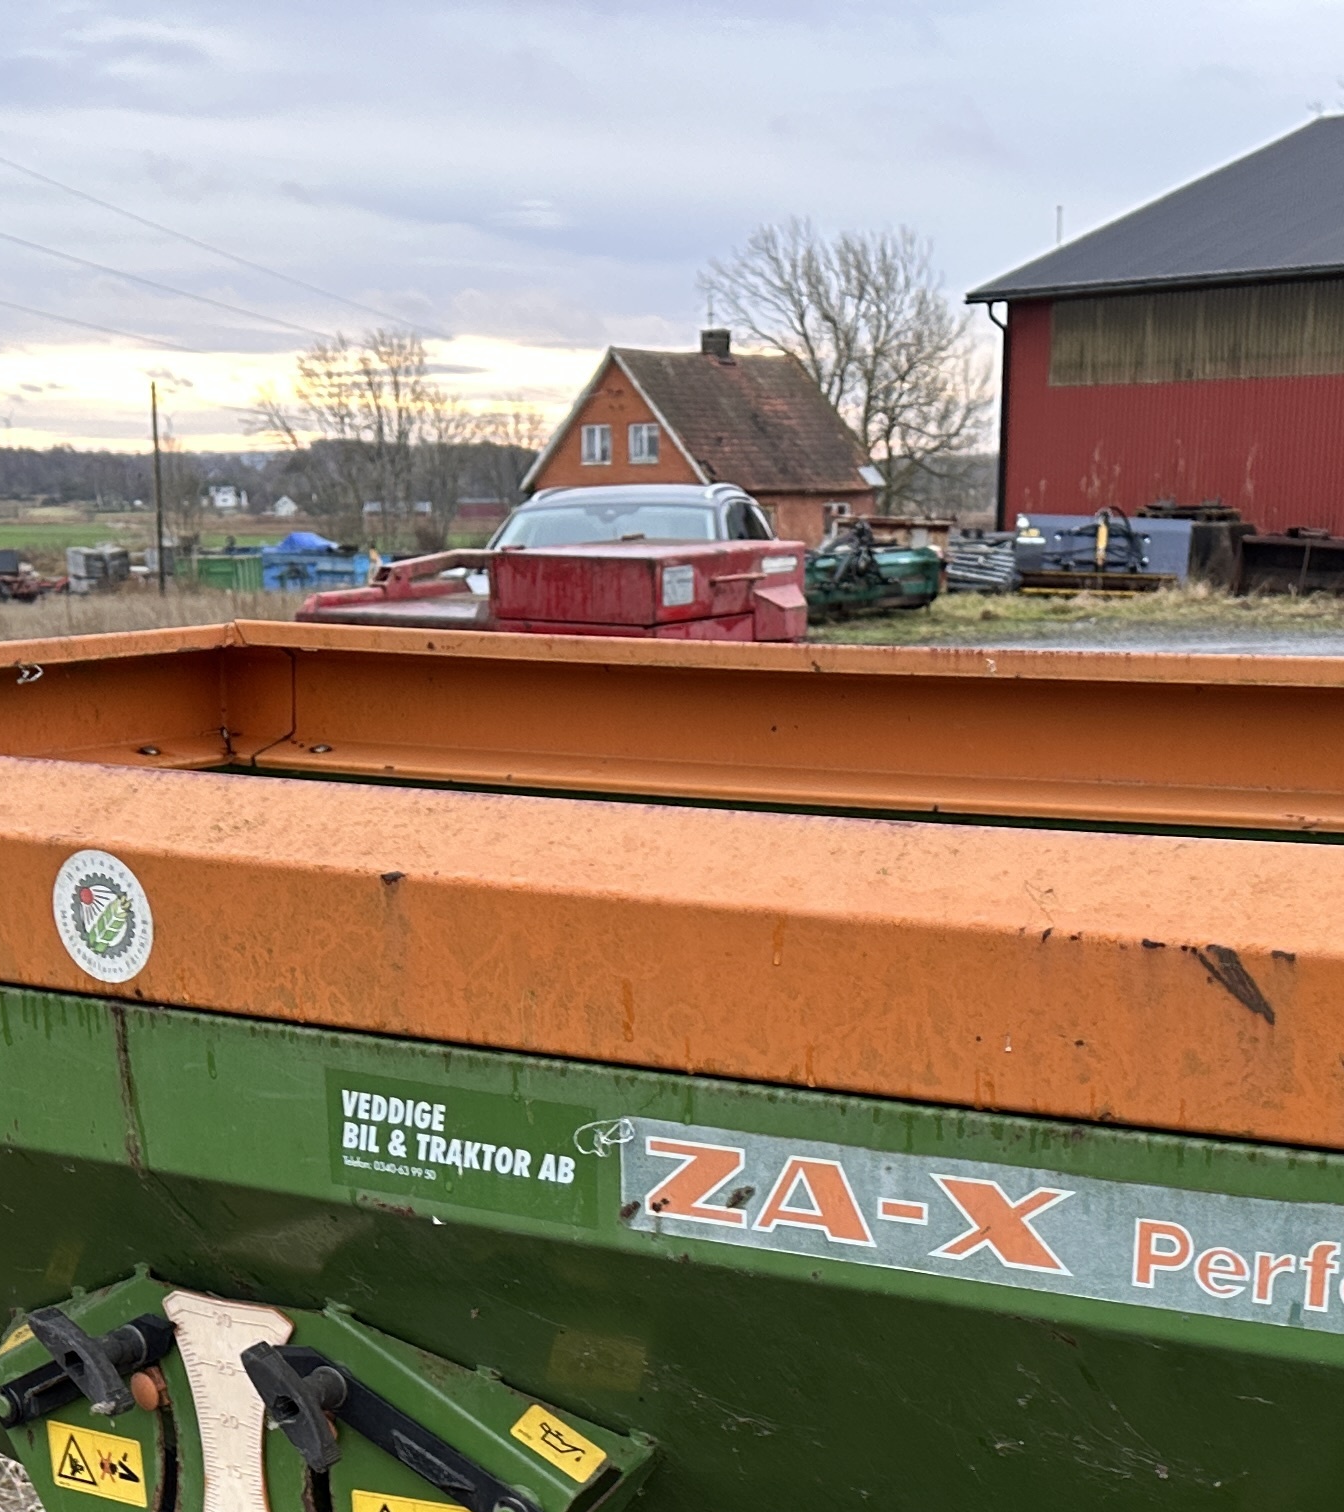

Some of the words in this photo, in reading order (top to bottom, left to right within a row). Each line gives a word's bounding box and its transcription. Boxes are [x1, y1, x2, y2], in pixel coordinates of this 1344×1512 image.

[342, 1089, 446, 1132] VEDDIGE
[342, 1121, 379, 1154] BIL
[388, 1129, 407, 1158] &
[416, 1133, 531, 1178] TRAKTOR
[538, 1153, 576, 1184] AB
[645, 1136, 1077, 1276] ZA-X
